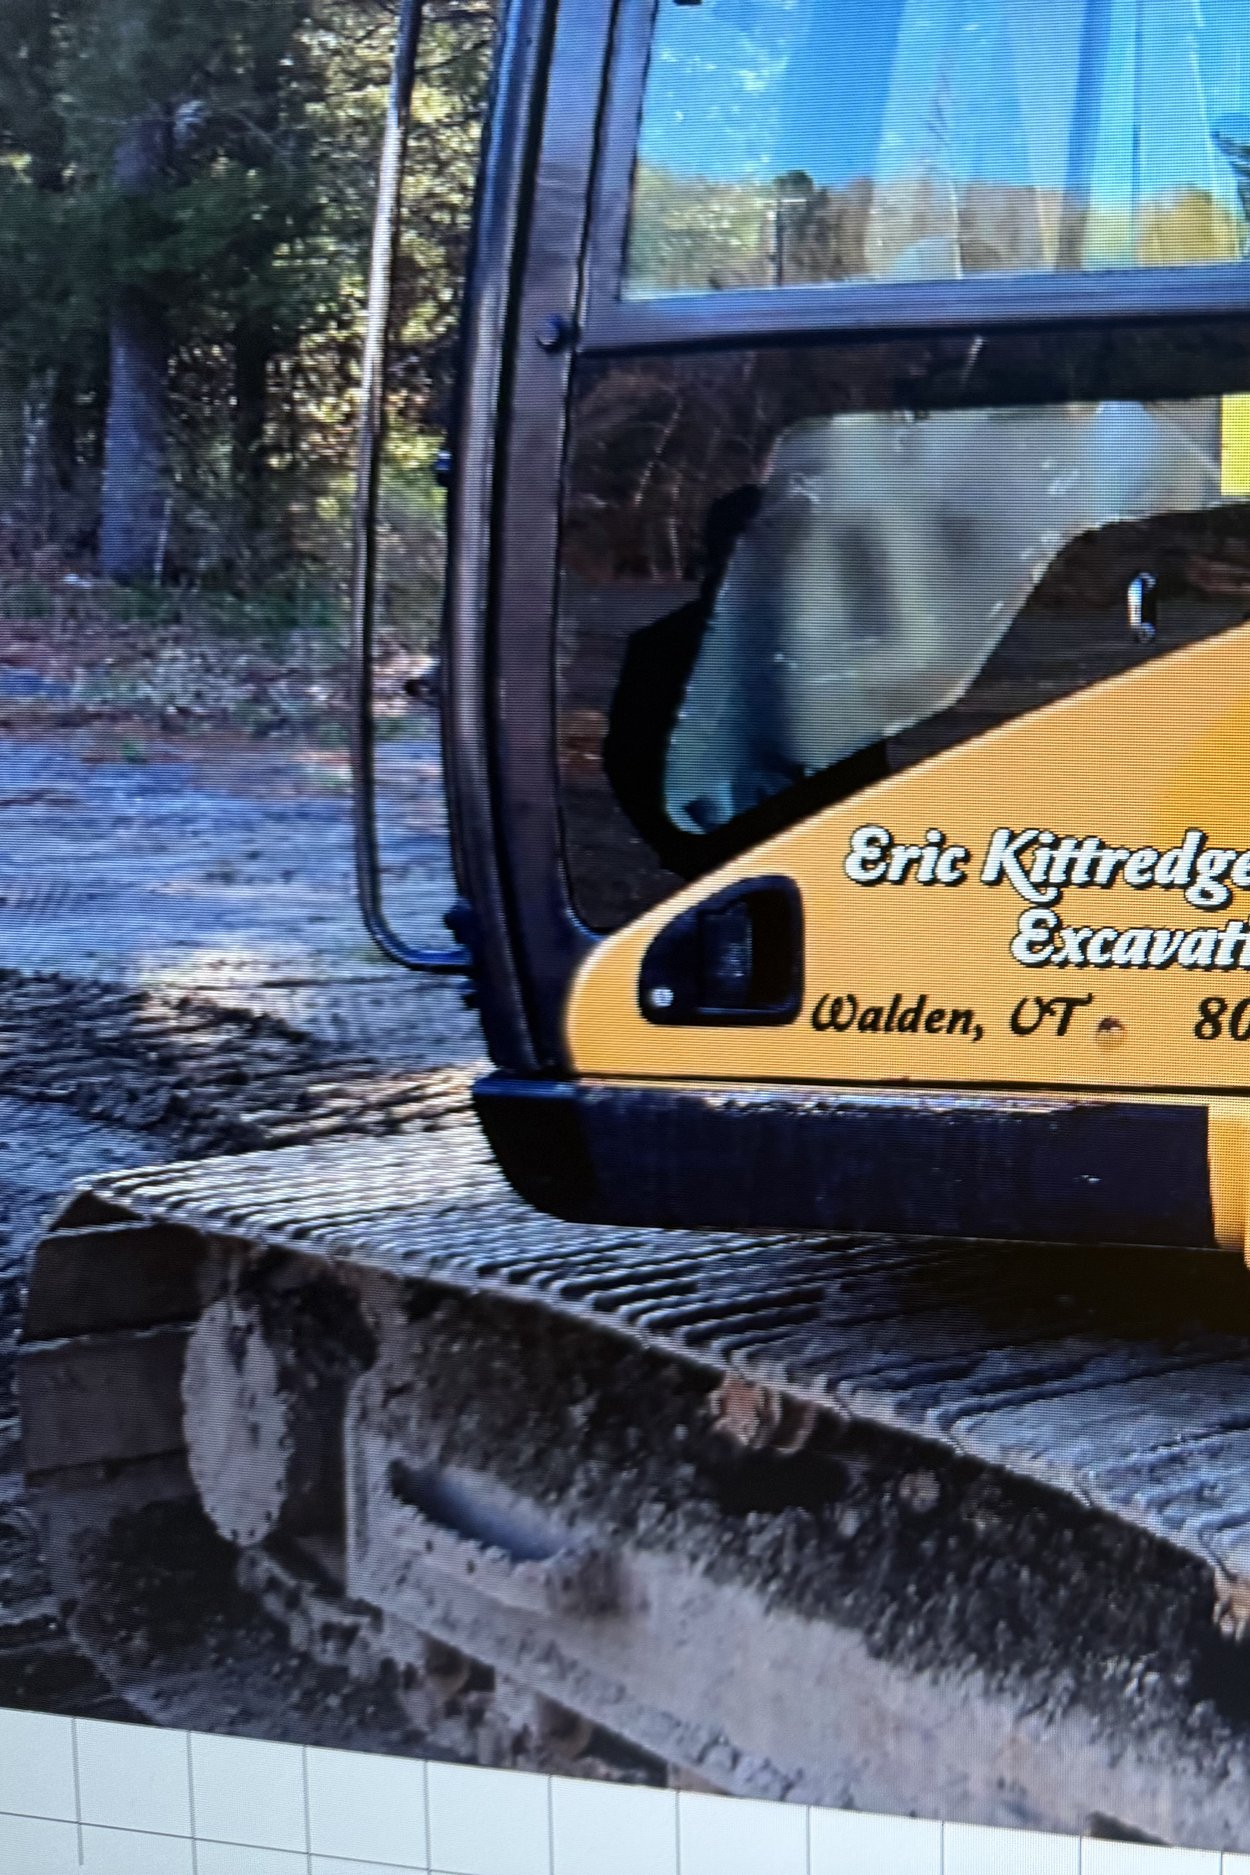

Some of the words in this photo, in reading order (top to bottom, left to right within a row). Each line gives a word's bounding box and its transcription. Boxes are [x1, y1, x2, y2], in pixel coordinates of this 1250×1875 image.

[844, 824, 968, 888] Eric
[810, 993, 984, 1042] Walden,
[1008, 992, 1094, 1038] VT
